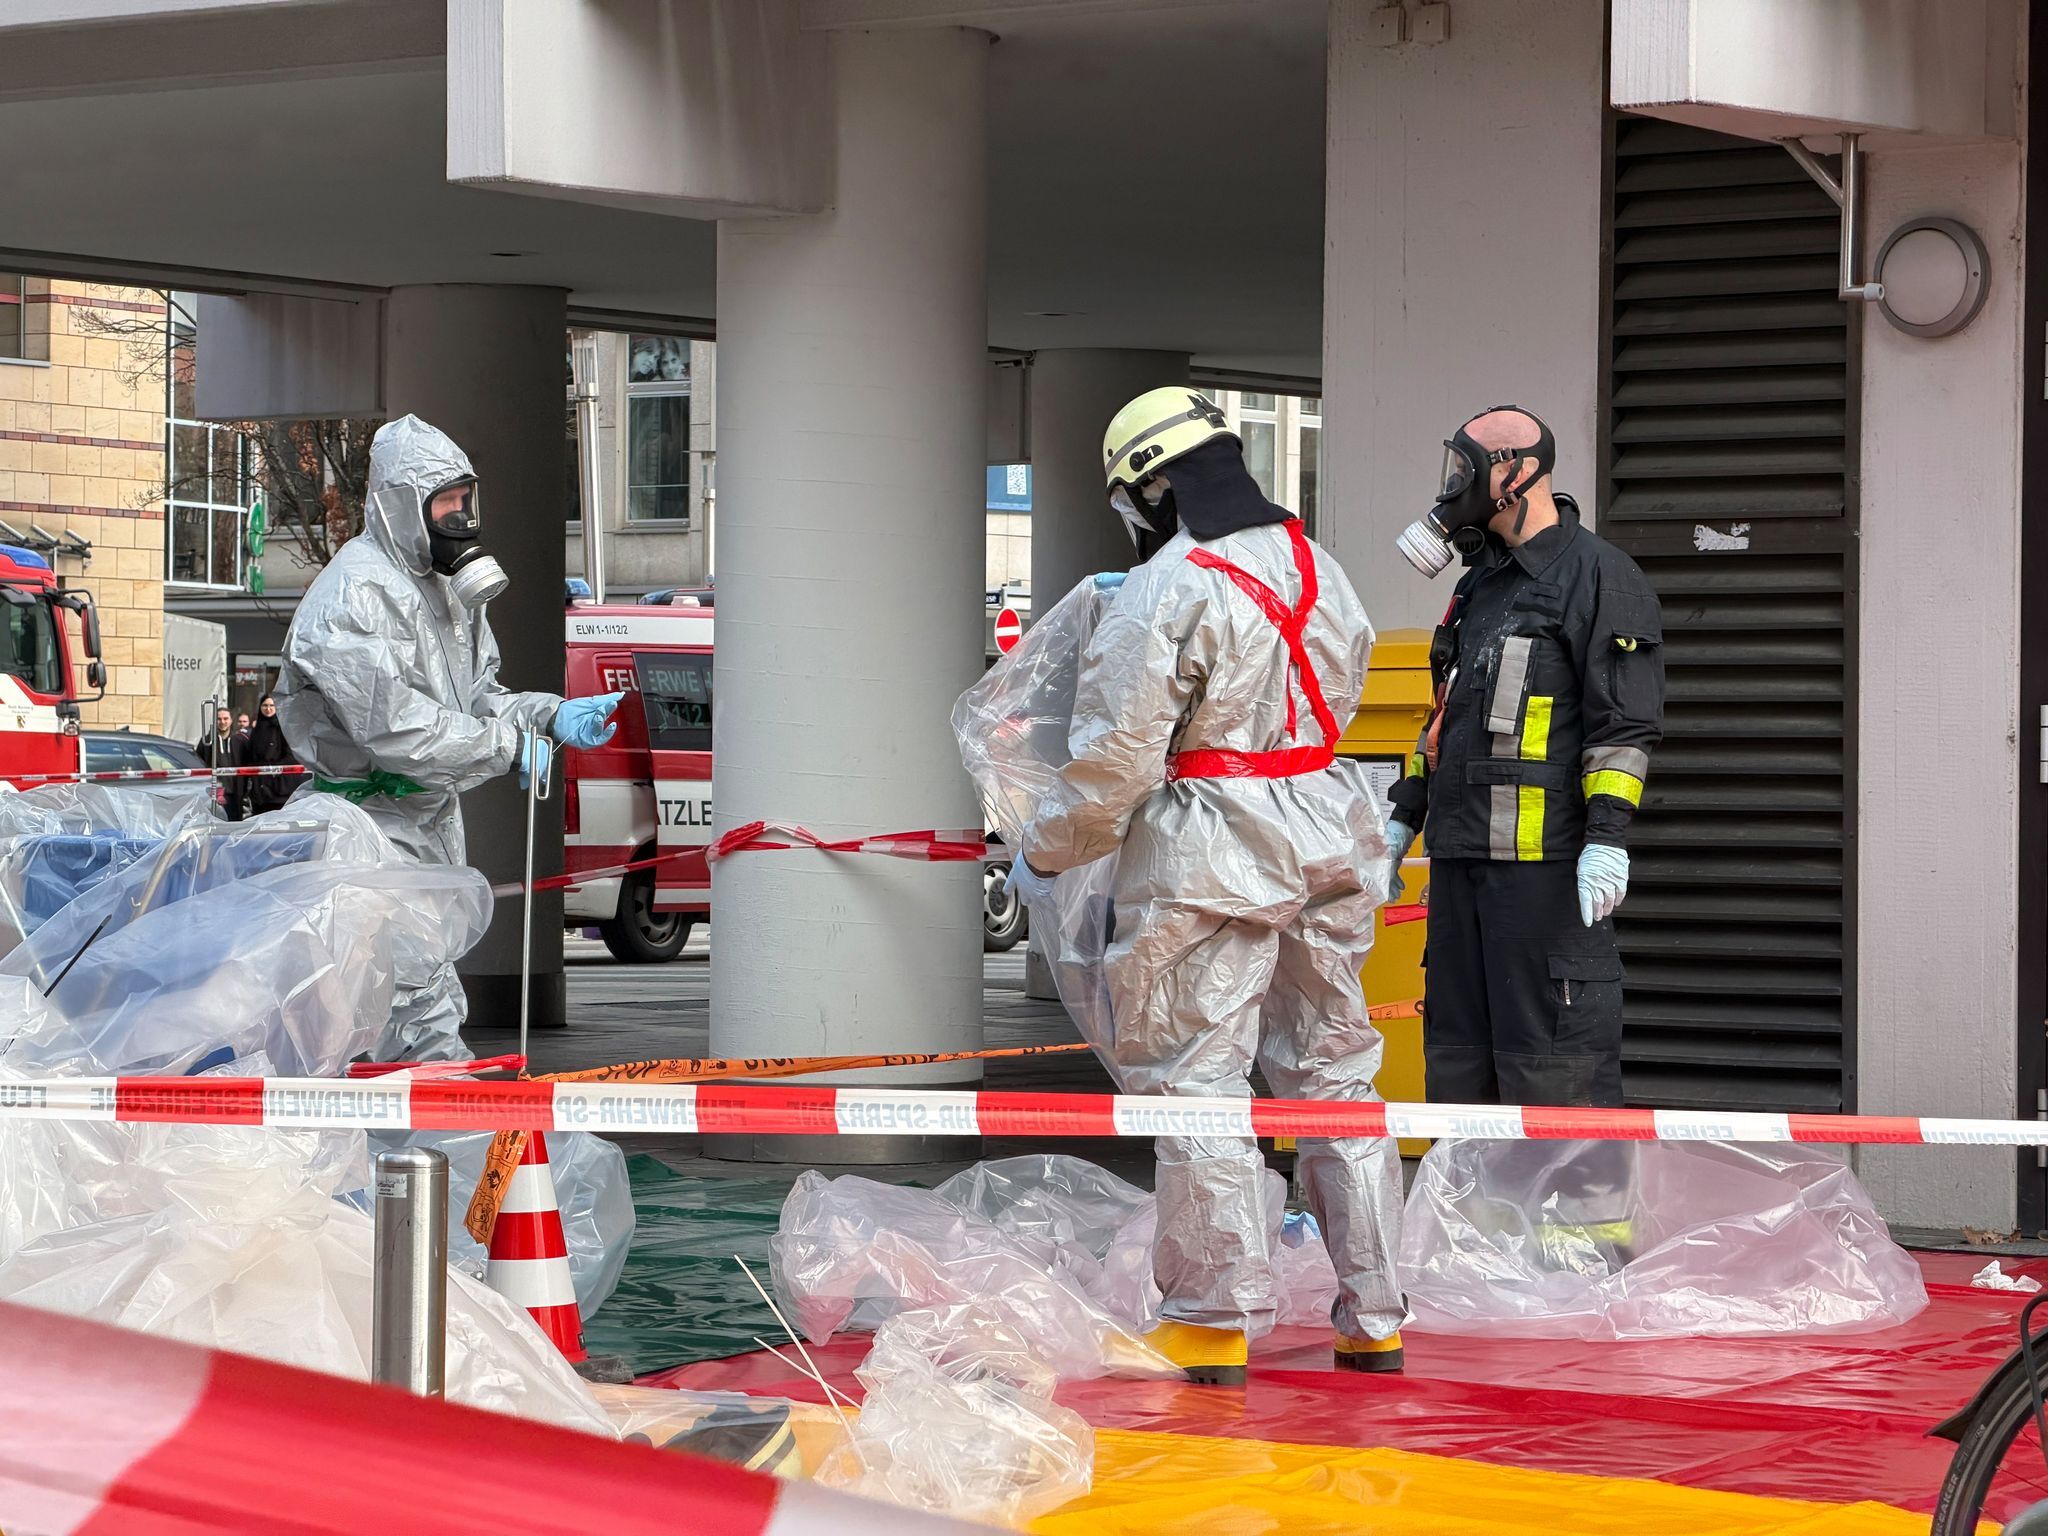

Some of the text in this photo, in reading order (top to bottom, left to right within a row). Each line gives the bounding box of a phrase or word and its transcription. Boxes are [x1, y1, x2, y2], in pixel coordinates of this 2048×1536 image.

[576, 625, 628, 635] ELW 1-1/12/2
[672, 703, 705, 727] 112
[657, 800, 713, 826] TZLE
